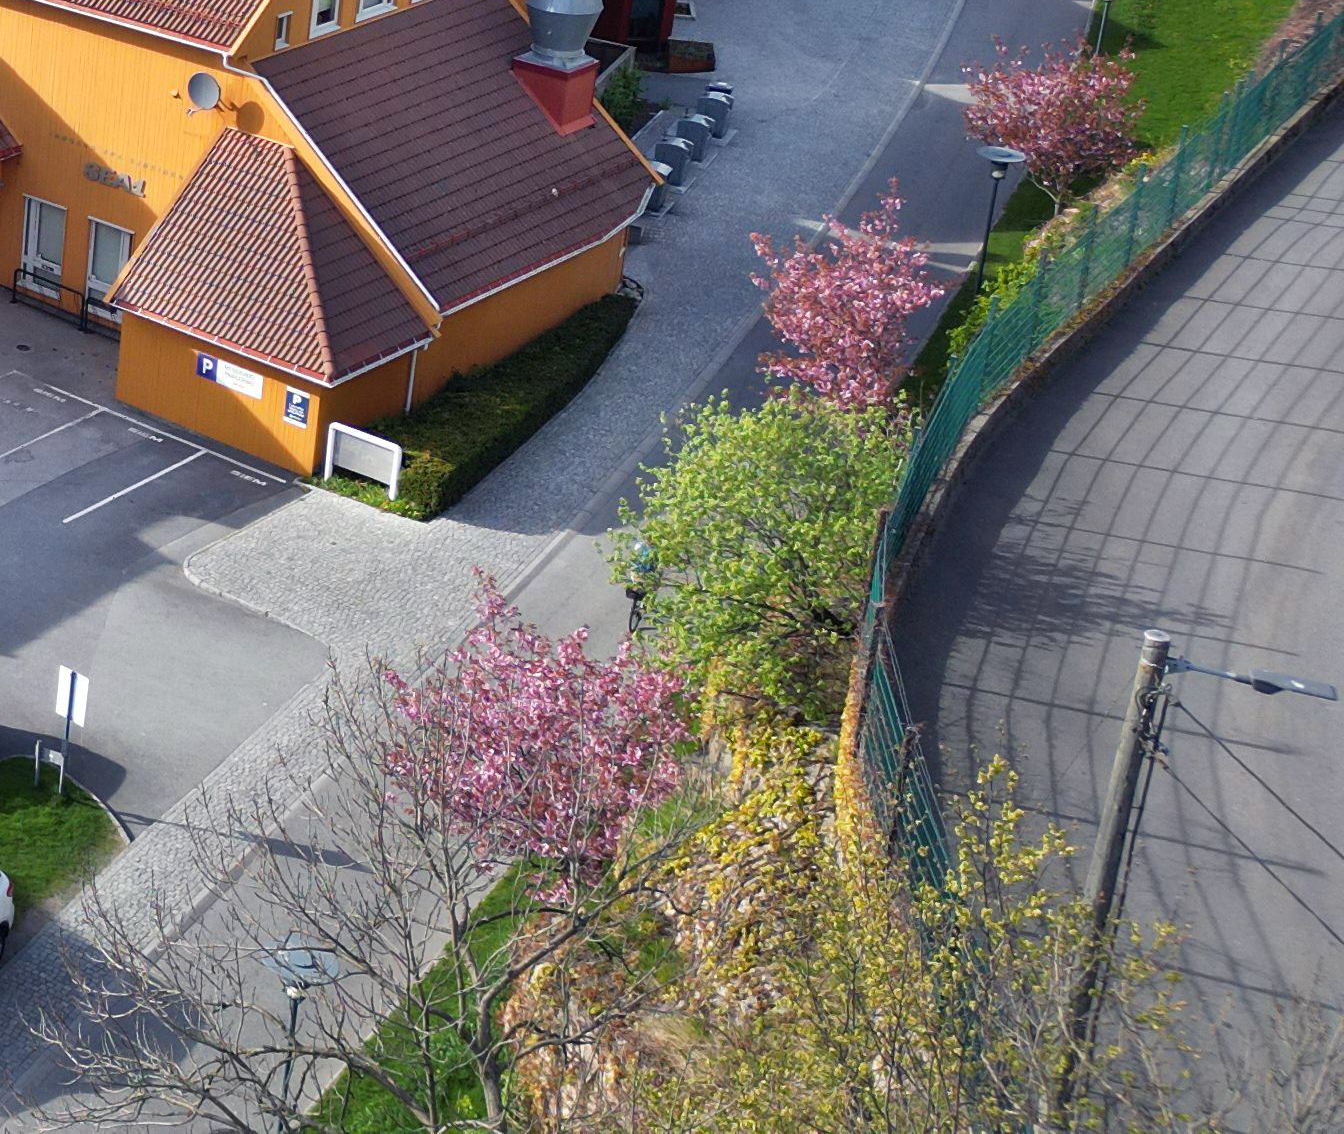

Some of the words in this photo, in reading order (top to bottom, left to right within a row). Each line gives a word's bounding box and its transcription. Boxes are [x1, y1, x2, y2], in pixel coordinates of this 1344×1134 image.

[202, 357, 214, 374] P
[292, 393, 302, 404] P
[230, 469, 267, 486] SIEM
